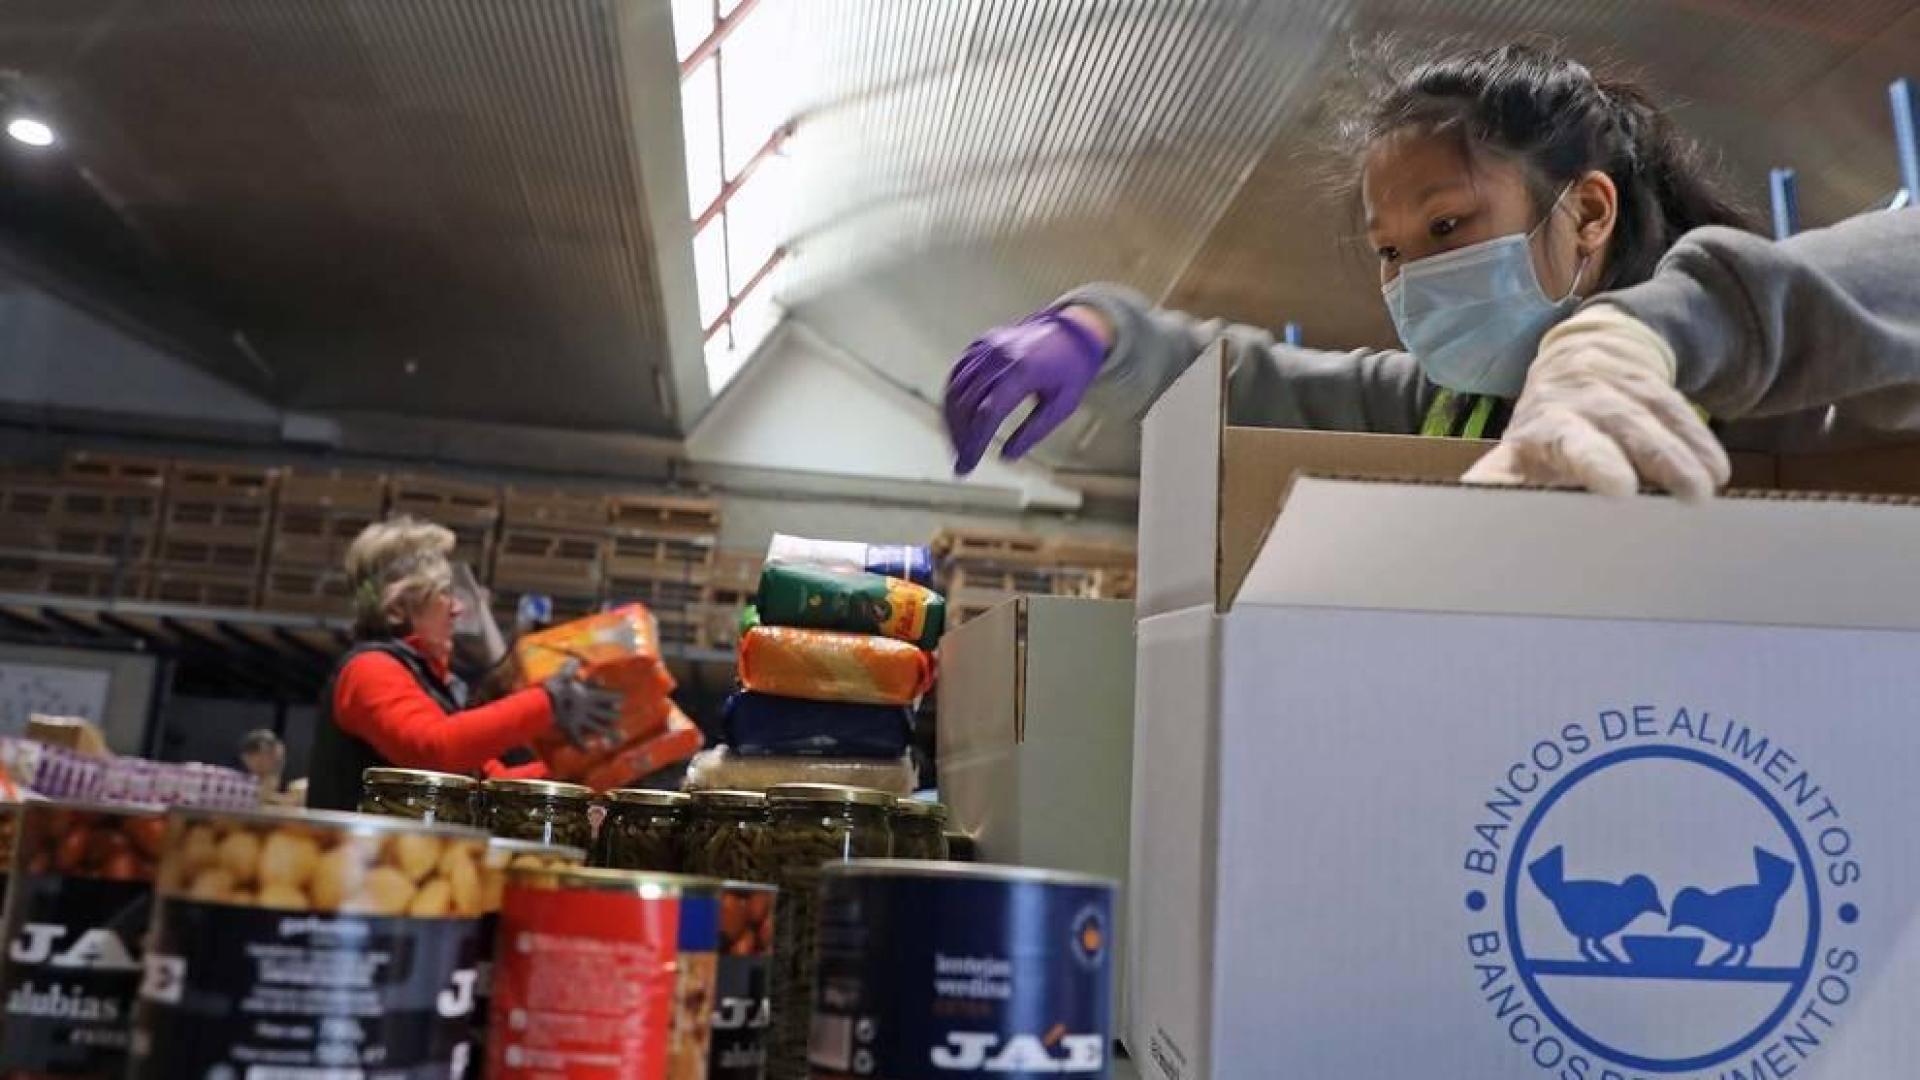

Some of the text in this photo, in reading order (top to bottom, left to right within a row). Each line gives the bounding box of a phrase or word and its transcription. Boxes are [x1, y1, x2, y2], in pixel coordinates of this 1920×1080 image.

[1463, 705, 1861, 887] BANCOS DE ALIMENTOS
[9, 922, 144, 970] JA
[1467, 931, 1591, 1080] BANCOS
